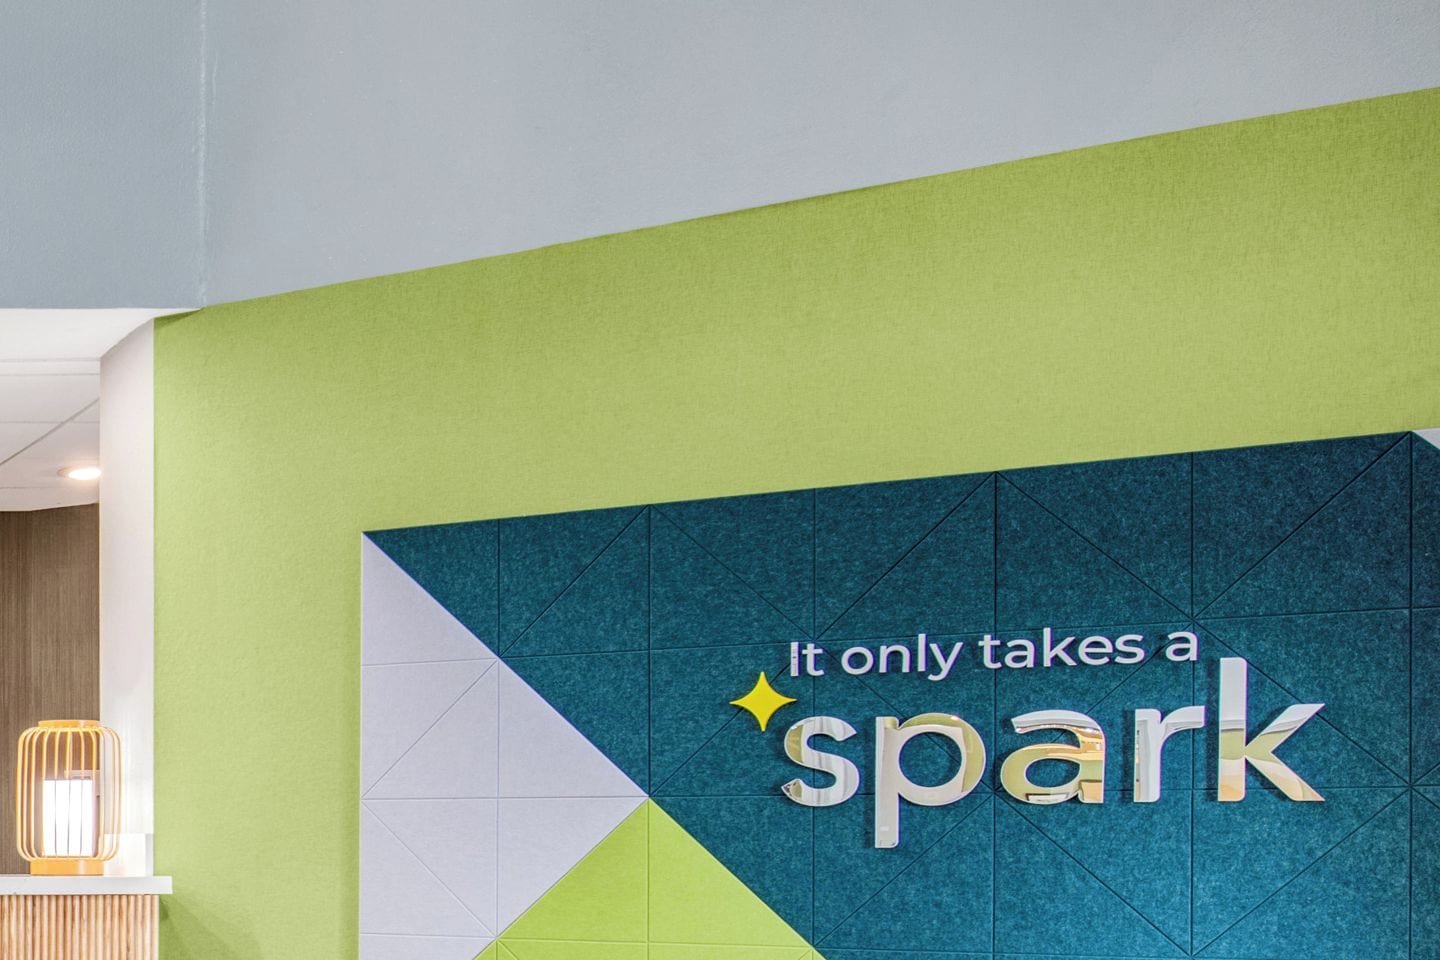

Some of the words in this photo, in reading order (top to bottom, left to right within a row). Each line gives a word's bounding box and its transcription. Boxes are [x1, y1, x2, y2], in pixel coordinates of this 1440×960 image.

[790, 641, 824, 677] It
[840, 633, 963, 681] only
[978, 628, 1146, 670] takes
[1165, 631, 1199, 662] a
[781, 657, 1326, 849] spark
